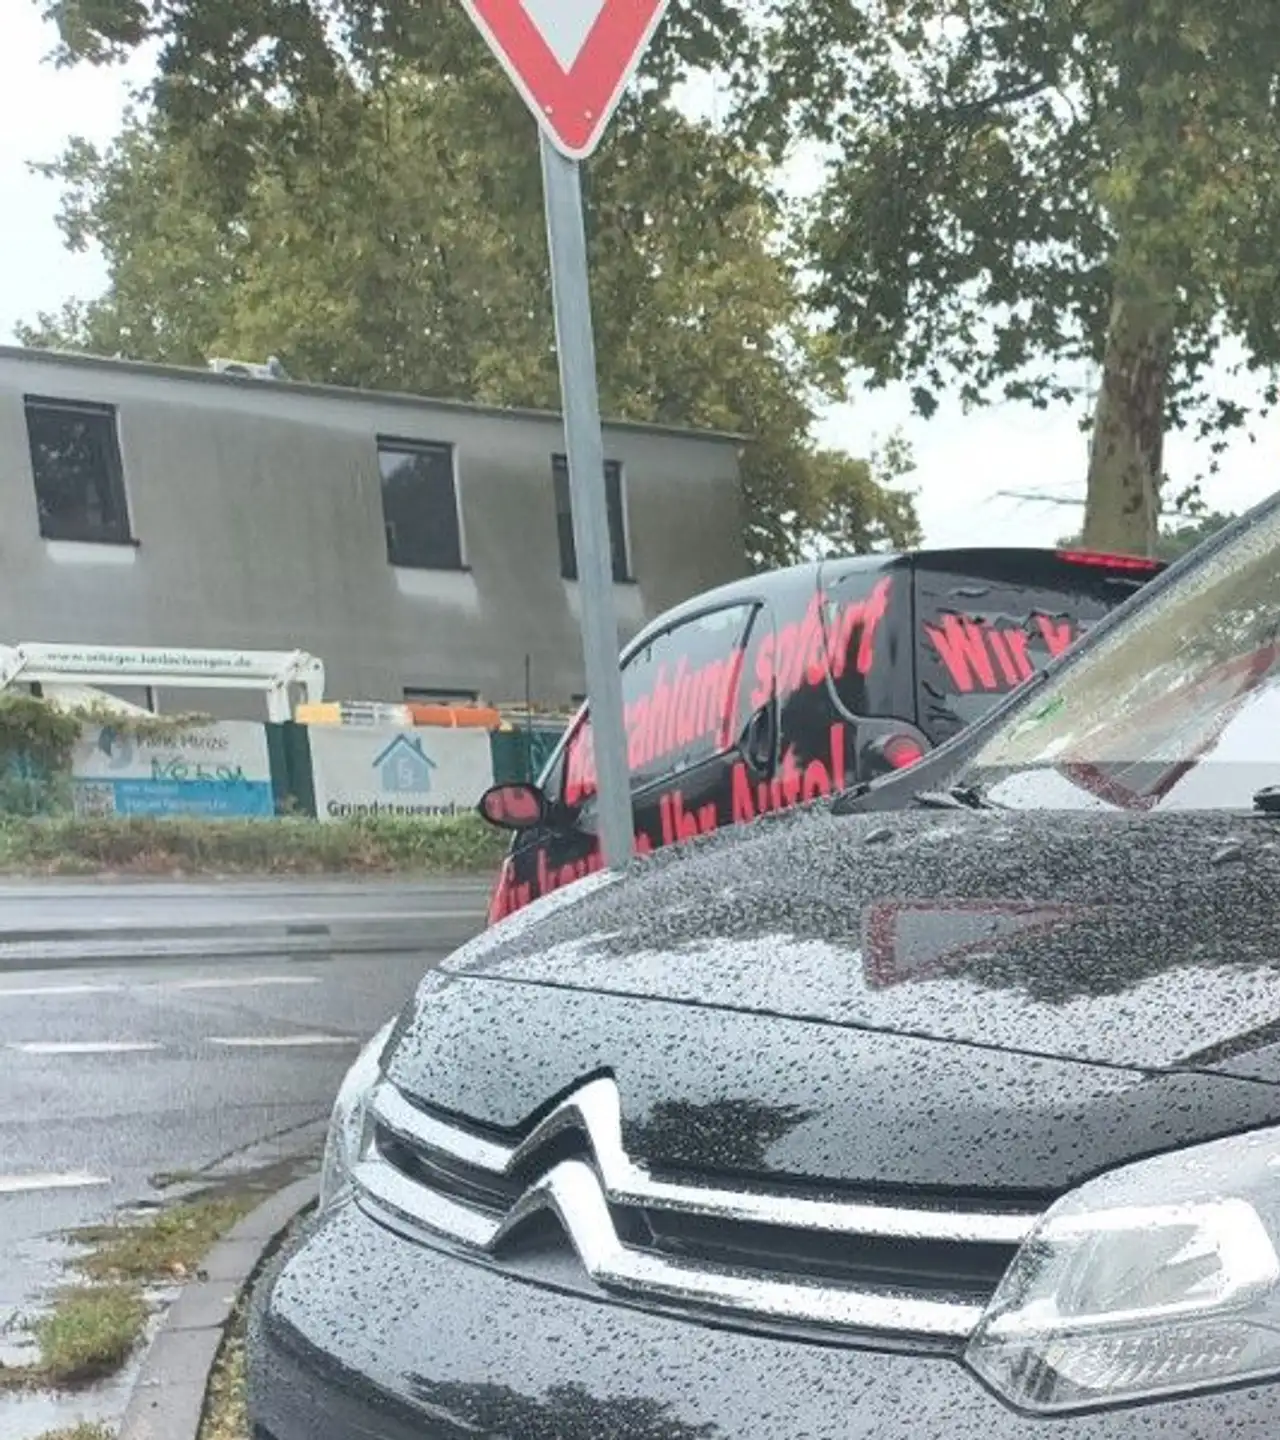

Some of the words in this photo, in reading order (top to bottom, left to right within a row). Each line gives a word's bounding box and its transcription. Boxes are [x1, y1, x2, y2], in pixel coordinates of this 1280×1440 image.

[752, 576, 894, 710] sofort
[925, 611, 1034, 692] Wir
[660, 789, 717, 846] Ihr
[731, 722, 846, 825] Auto!
